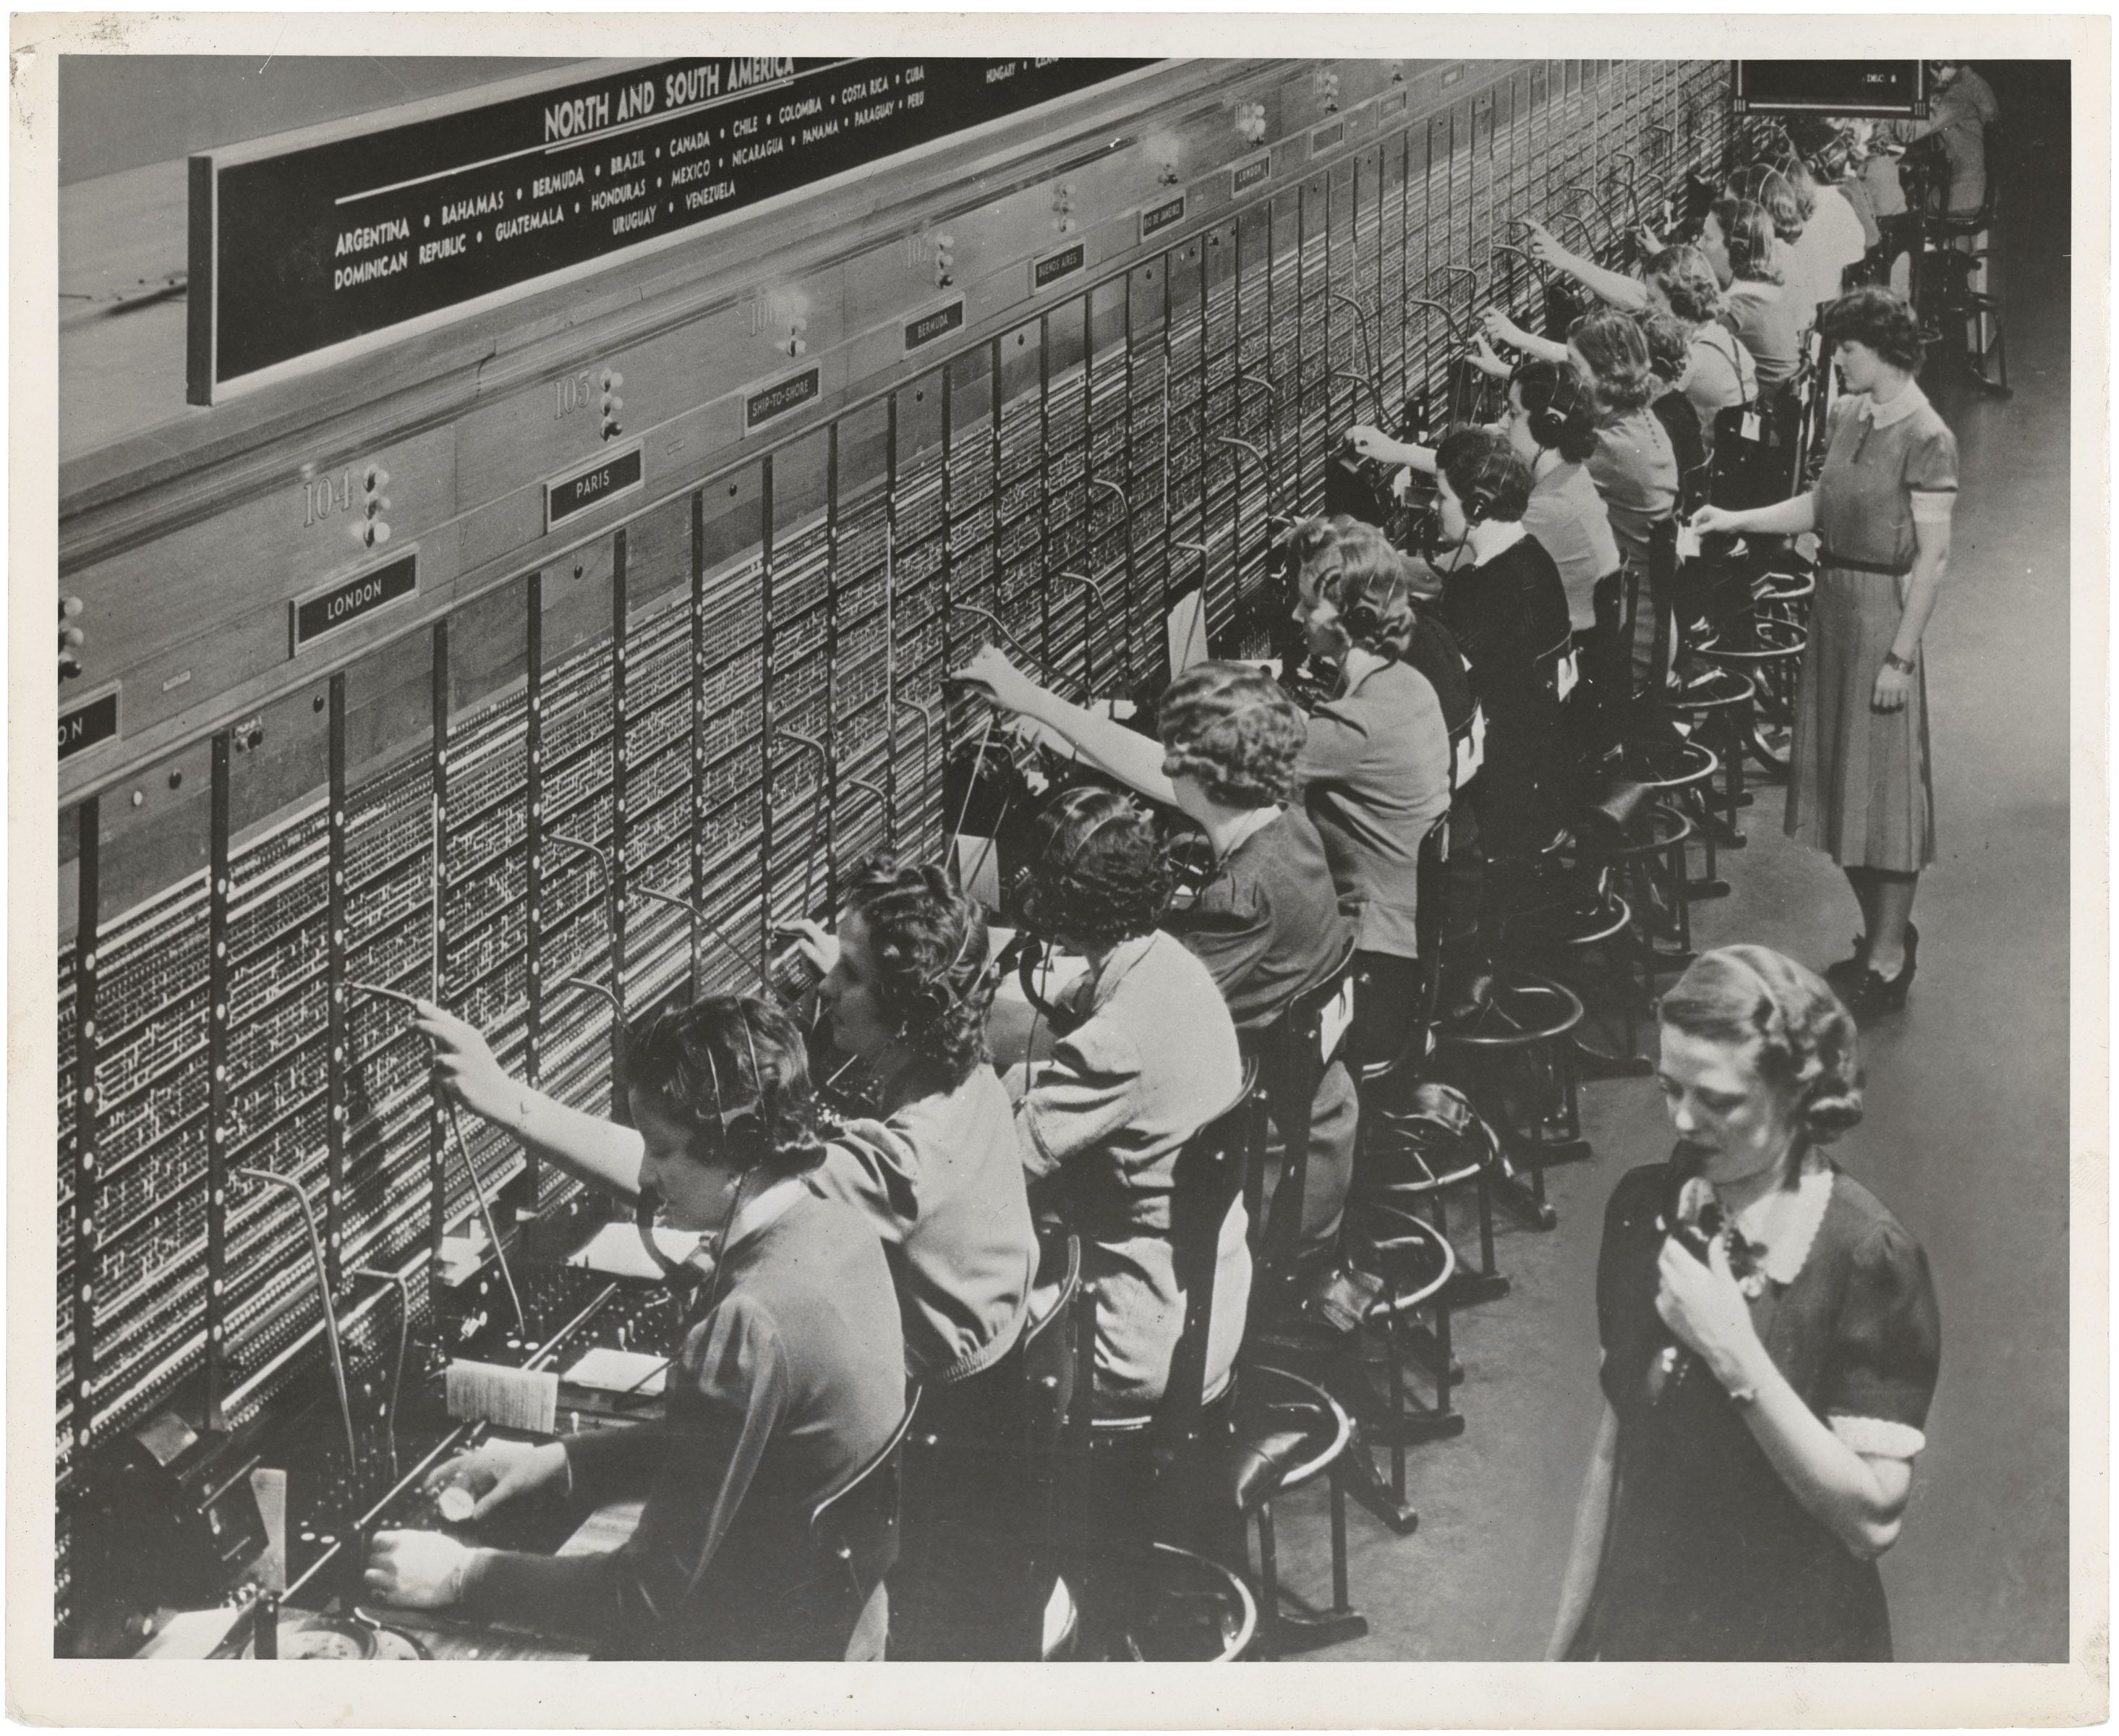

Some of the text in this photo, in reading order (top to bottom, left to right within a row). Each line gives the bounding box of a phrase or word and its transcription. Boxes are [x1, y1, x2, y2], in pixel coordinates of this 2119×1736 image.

[986, 63, 1015, 82] HUNGARY
[545, 58, 793, 141] NORTH AND SOUTH AMERICA
[336, 66, 924, 256] ARGENTINA BAHAMAS BERMUDA BRAZIL CANADA CHILE COLOMBIA COSTA RICA CUBA
[335, 91, 924, 290] DOMINICAN REPUBLIC GUATEMALA HONDURAS MEXICO NICARAGUA PANAMA PARAGUAY PERU
[613, 181, 735, 234] URUGUAY VENEZUELA
[1039, 252, 1077, 277] BUENOS AIRES
[918, 314, 947, 338] BERMUDA
[555, 370, 592, 420] 105
[753, 380, 808, 417] SHIP-TO-SHORE
[304, 467, 352, 528] 104
[576, 470, 609, 498] PARIS
[328, 579, 380, 620] LONDON
